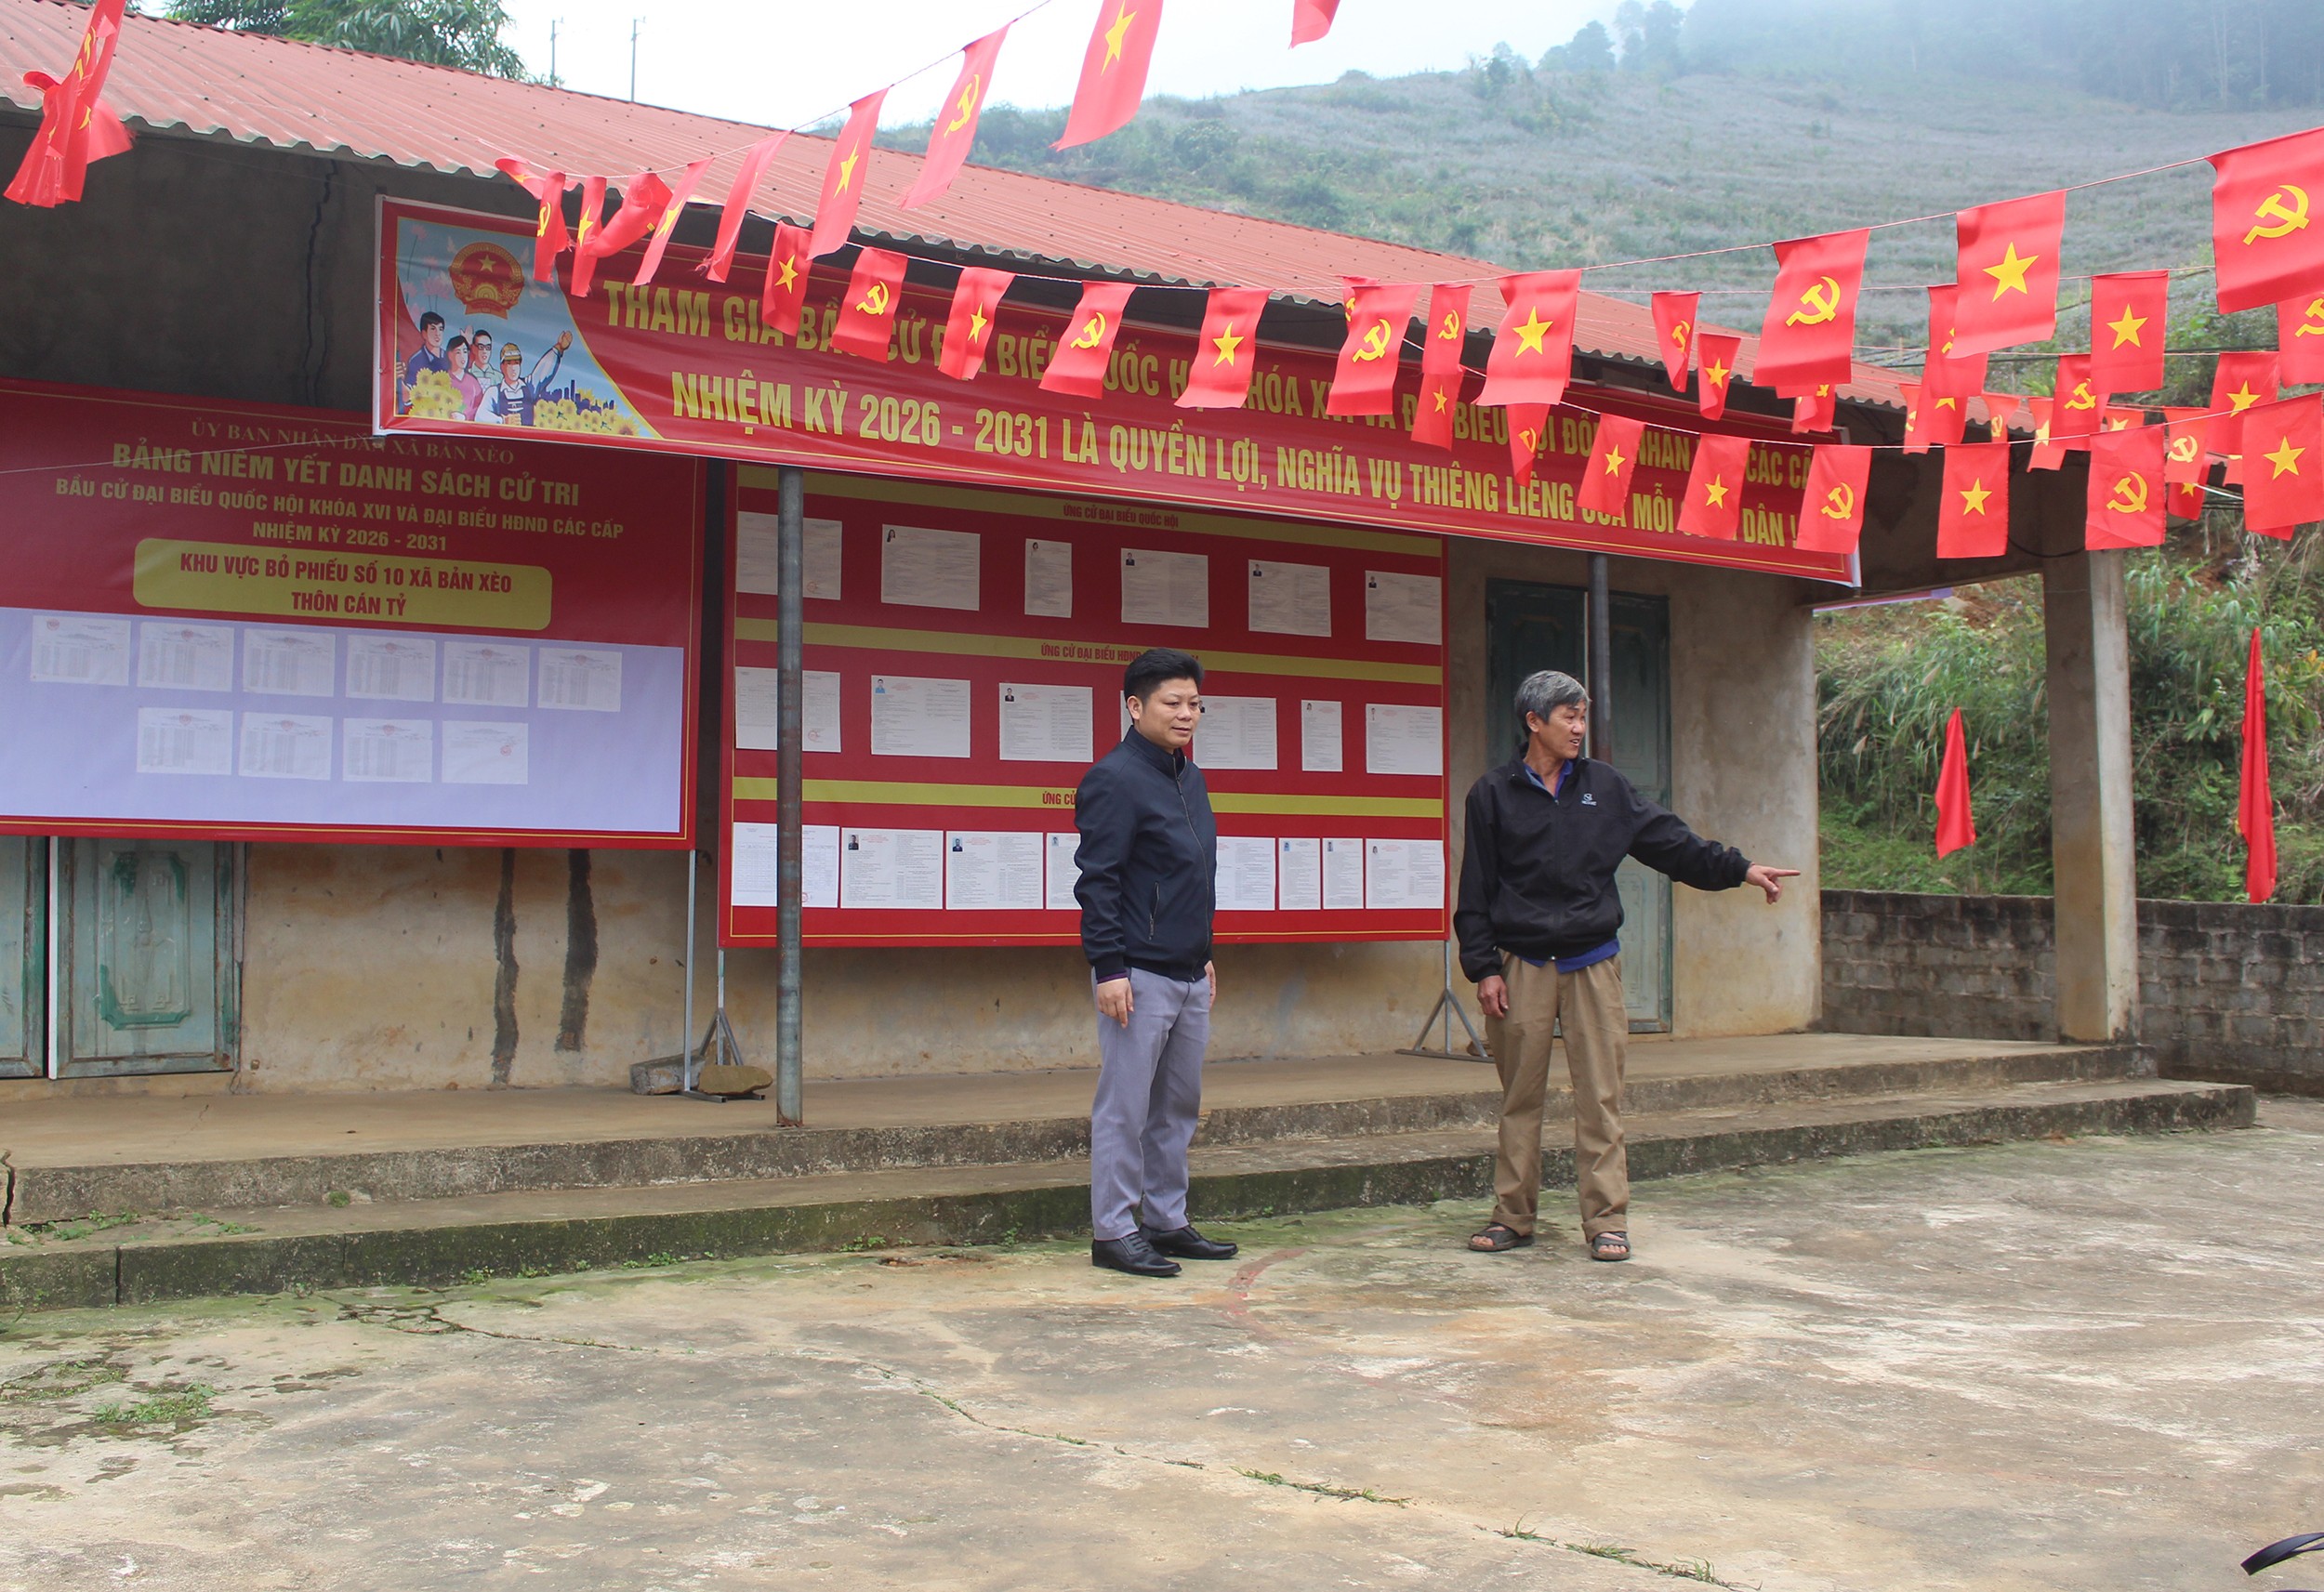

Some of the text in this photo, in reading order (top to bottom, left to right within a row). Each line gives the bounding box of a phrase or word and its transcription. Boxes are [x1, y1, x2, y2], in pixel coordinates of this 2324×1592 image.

[603, 280, 710, 337] THAM
[1103, 338, 1159, 396] UỐC
[1241, 364, 1303, 416] HÓA
[1746, 442, 1783, 486] CÁC
[191, 416, 221, 438] ỦY
[228, 425, 271, 442] BAN
[278, 428, 337, 449] NHÂN
[392, 438, 419, 455] XÃ
[473, 446, 514, 465] XÈO
[671, 369, 792, 435] NHIỆM
[804, 379, 848, 435] KỲ
[859, 394, 941, 446] 2026
[952, 425, 964, 435] -
[975, 408, 1048, 459] 2031
[1063, 412, 1100, 465] LÀ
[1109, 419, 1206, 479] QUYỀN
[1216, 437, 1268, 492] LỢI,
[1276, 445, 1362, 496] NGHĨA
[1367, 458, 1402, 509] VỤ
[1409, 460, 1499, 513] THIÊNG
[1506, 470, 1575, 521] LIÊNG
[1632, 482, 1674, 534] MỖI
[1742, 505, 1786, 546] DÂN
[112, 437, 579, 506] BẢNG NIÊM YẾT DANH SÁCH CỬ TRI
[56, 473, 624, 539] BẦU CỬ ĐẠI BIỂU QUỐC HỘI KHÓA XVI VÀ ĐẠI BIỂU HĐND CÁC CẤP
[1063, 503, 1179, 529] ỨNG CỬ ĐẠI BIỂU QUỐC HỘI
[253, 520, 312, 544] NHIỆM
[318, 524, 340, 545] KỲ
[346, 529, 389, 547] 2026
[406, 534, 446, 551] 2031
[180, 553, 512, 593] KHU VỰC BỎ PHIẾU SỐ 10 XÃ BẢN XÈO
[291, 589, 406, 616] THÔN CÁN TỶ
[1041, 642, 1060, 656] ỨNG
[1063, 643, 1076, 658] CỬ
[1077, 648, 1092, 661] ĐẠI
[1094, 645, 1116, 661] BIỂU
[1042, 790, 1062, 805] ỨNG
